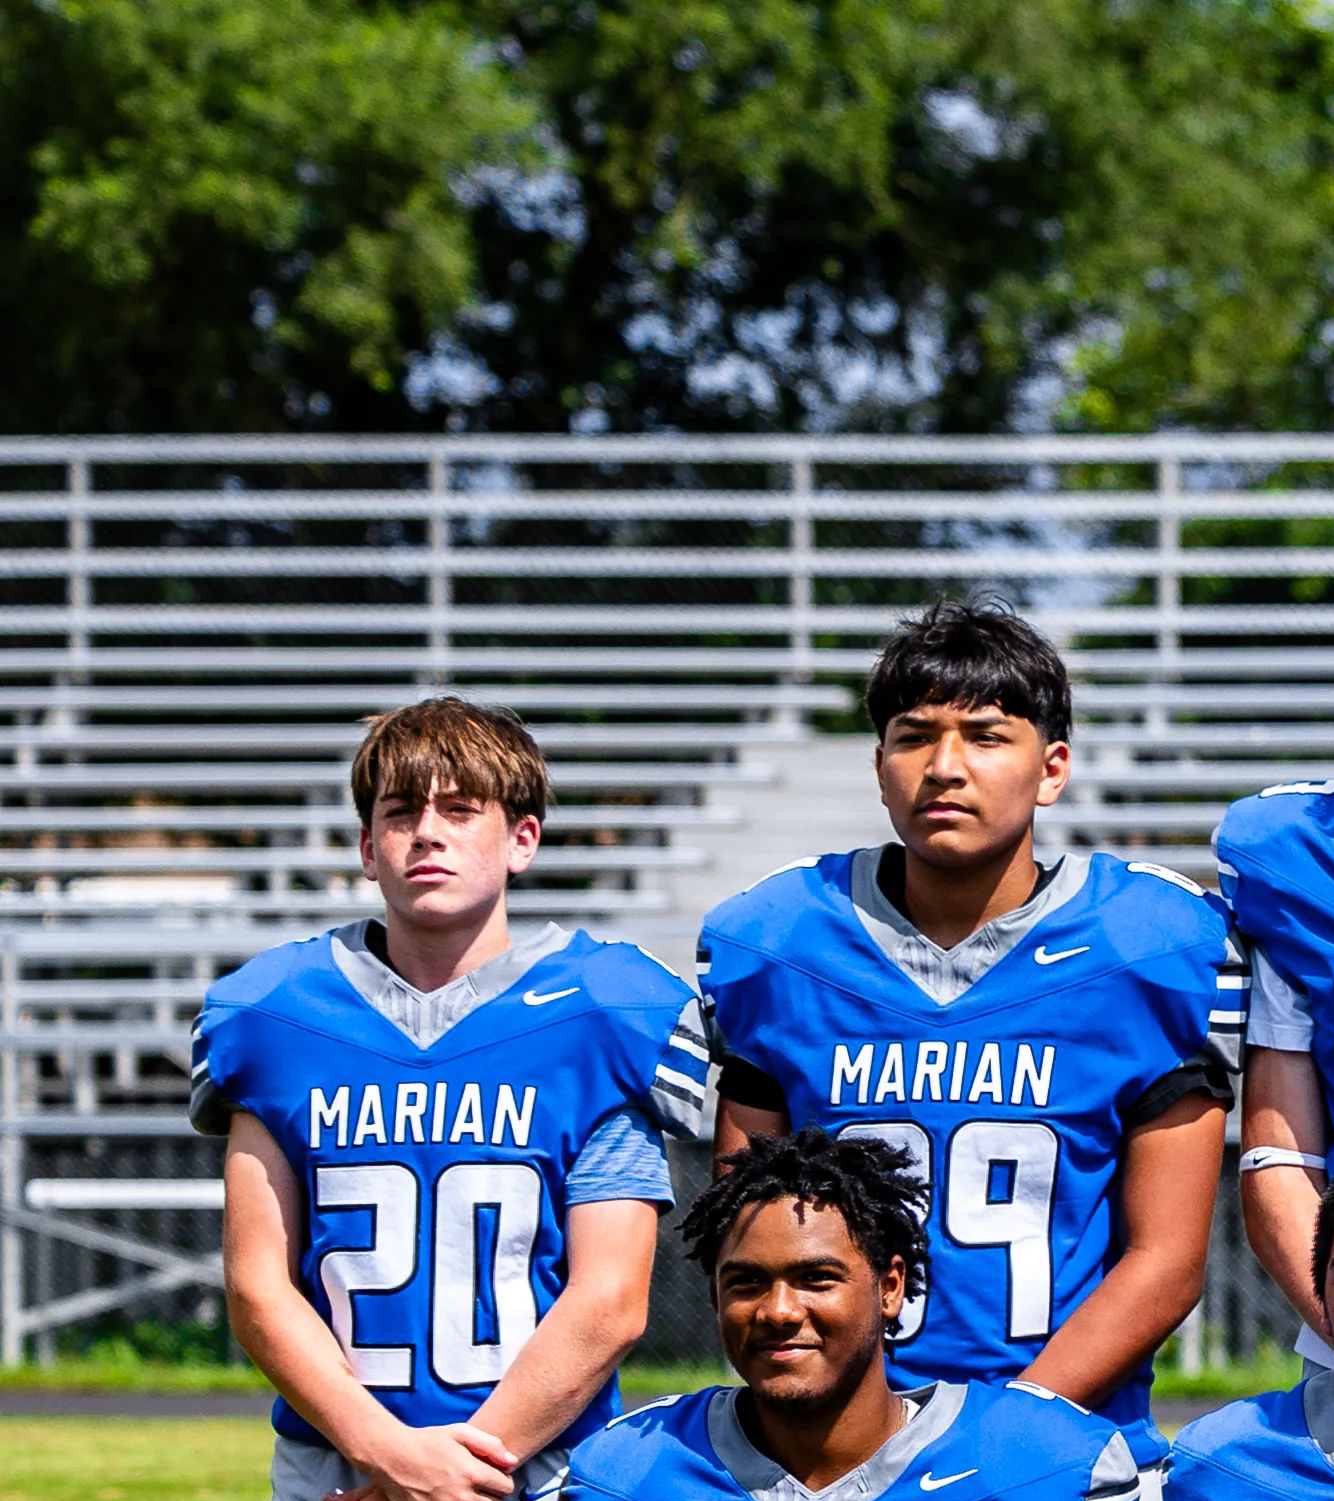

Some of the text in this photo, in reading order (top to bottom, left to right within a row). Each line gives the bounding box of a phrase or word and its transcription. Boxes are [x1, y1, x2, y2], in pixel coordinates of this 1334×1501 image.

[829, 1040, 1056, 1107] MARIAN
[309, 1081, 537, 1149] MARIAN
[315, 1162, 543, 1388] 20
